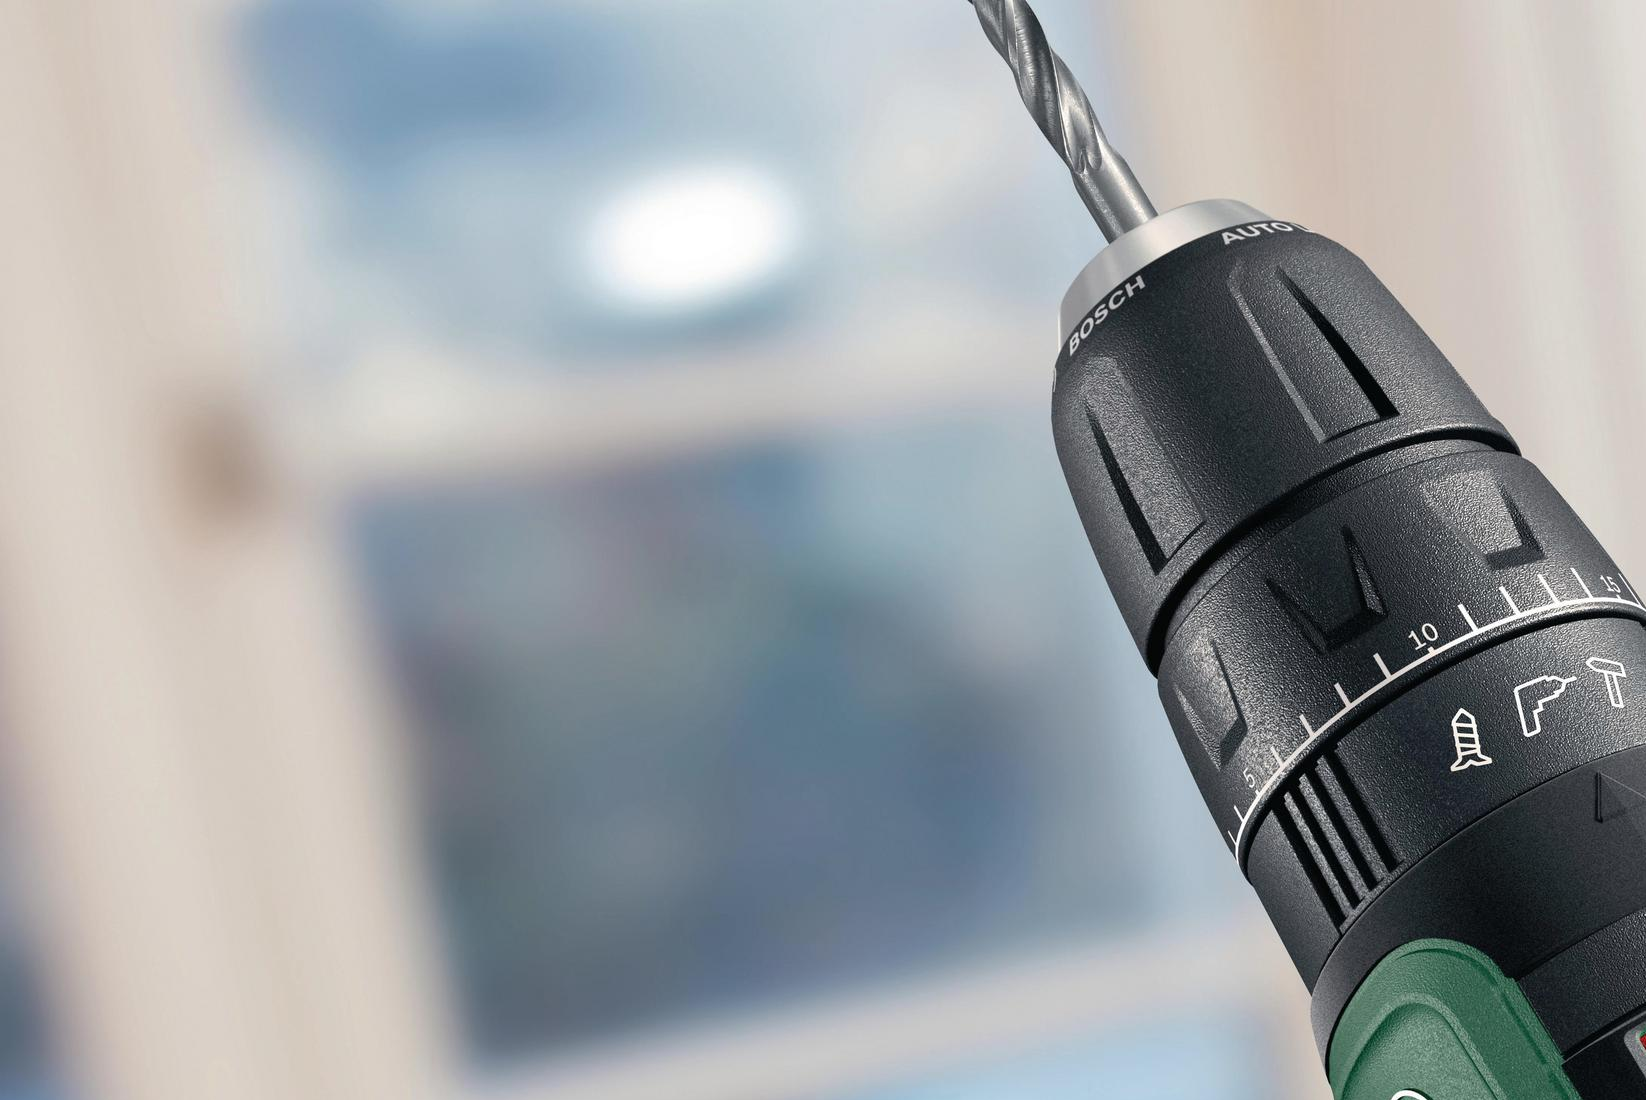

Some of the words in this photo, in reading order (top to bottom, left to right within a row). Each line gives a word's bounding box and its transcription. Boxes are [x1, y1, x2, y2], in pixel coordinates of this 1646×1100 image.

[1221, 222, 1293, 245] AUTO
[1069, 275, 1146, 356] BOSCH
[1600, 575, 1621, 593] 15
[1408, 623, 1438, 650] 10
[1243, 767, 1256, 788] 5
